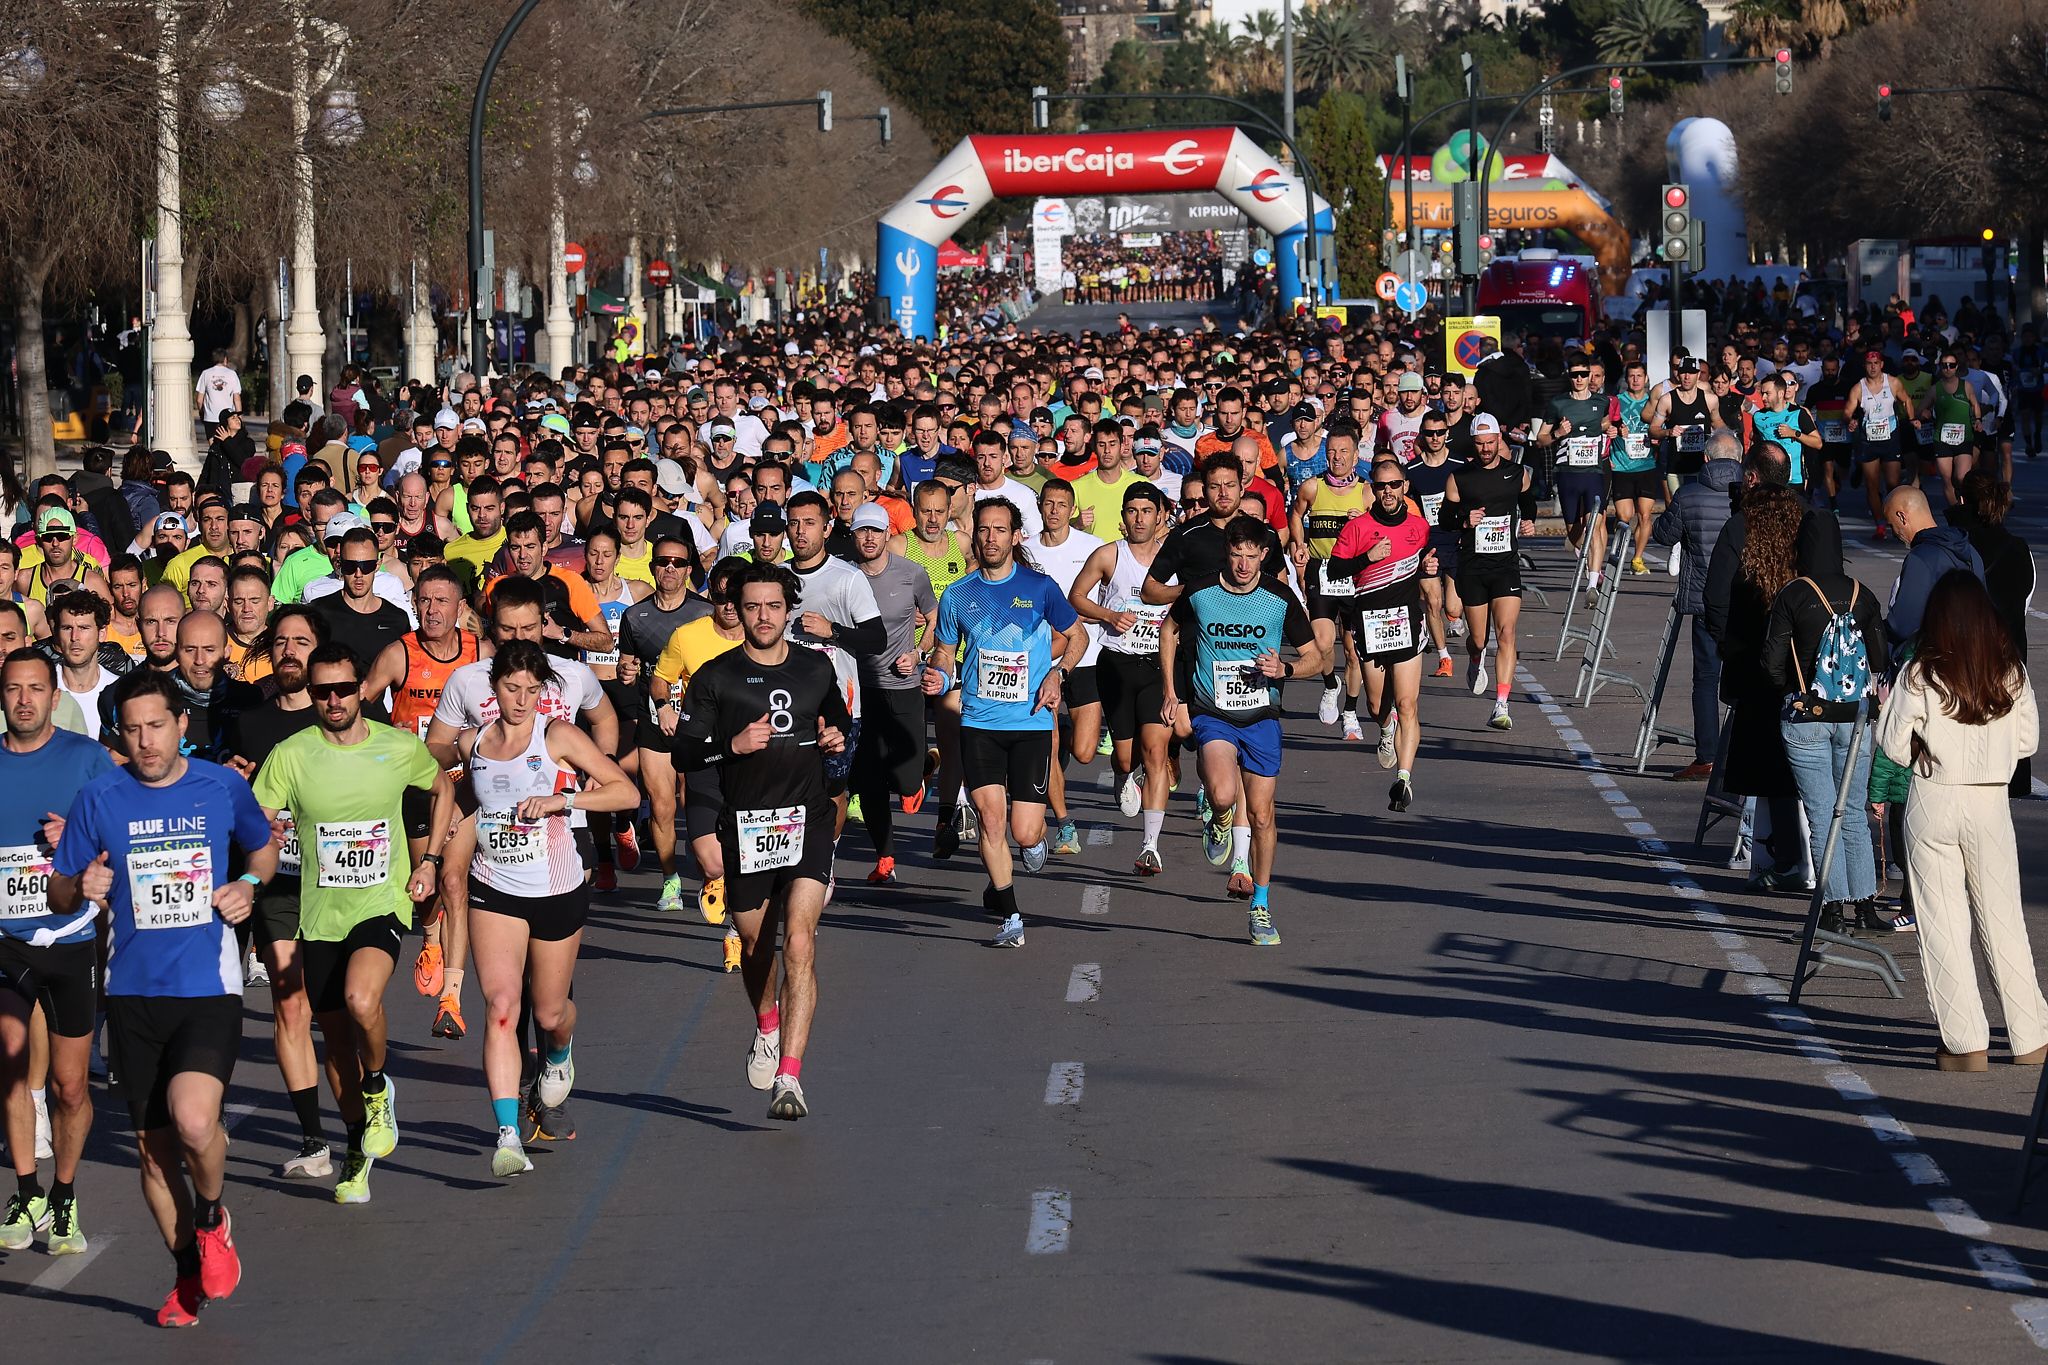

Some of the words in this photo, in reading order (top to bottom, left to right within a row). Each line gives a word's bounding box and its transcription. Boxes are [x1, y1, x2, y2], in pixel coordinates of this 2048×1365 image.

[1003, 146, 1134, 177] iberCaja
[1108, 205, 1150, 231] 10K
[1188, 205, 1239, 218] KIPRUN
[1487, 205, 1558, 224] eguros
[1575, 448, 1594, 457] 4638
[1312, 520, 1344, 529] CORREC
[1484, 531, 1505, 542] 4815
[1132, 624, 1160, 639] 4743
[1206, 622, 1267, 638] CRESPO
[1374, 624, 1401, 640] 5565
[1214, 640, 1258, 651] RUNNERS
[1375, 640, 1404, 651] KIPRUN
[980, 652, 1010, 663] iberCaja
[987, 671, 1018, 687] 2709
[409, 688, 442, 699] NEVE
[986, 690, 1019, 700] KIPRUN
[1226, 697, 1260, 708] KIPRUN
[768, 688, 794, 733] GO
[128, 819, 164, 836] BLUE
[168, 816, 206, 832] LINE
[740, 815, 780, 824] iberCaja
[283, 838, 300, 856] 50
[489, 832, 529, 849] 5693
[755, 833, 790, 853] 5014
[131, 857, 180, 870] iberCaja
[335, 848, 375, 868] 4610
[492, 852, 534, 865] KIPRUN
[754, 855, 790, 869] KIPRUN
[281, 861, 301, 873] KIP
[334, 873, 376, 884] KIPRUN
[7, 874, 48, 897] 6460
[151, 881, 195, 905] 5138
[202, 896, 208, 905] 7
[8, 903, 48, 915] KIPRU
[150, 911, 200, 925] KIPRUN
